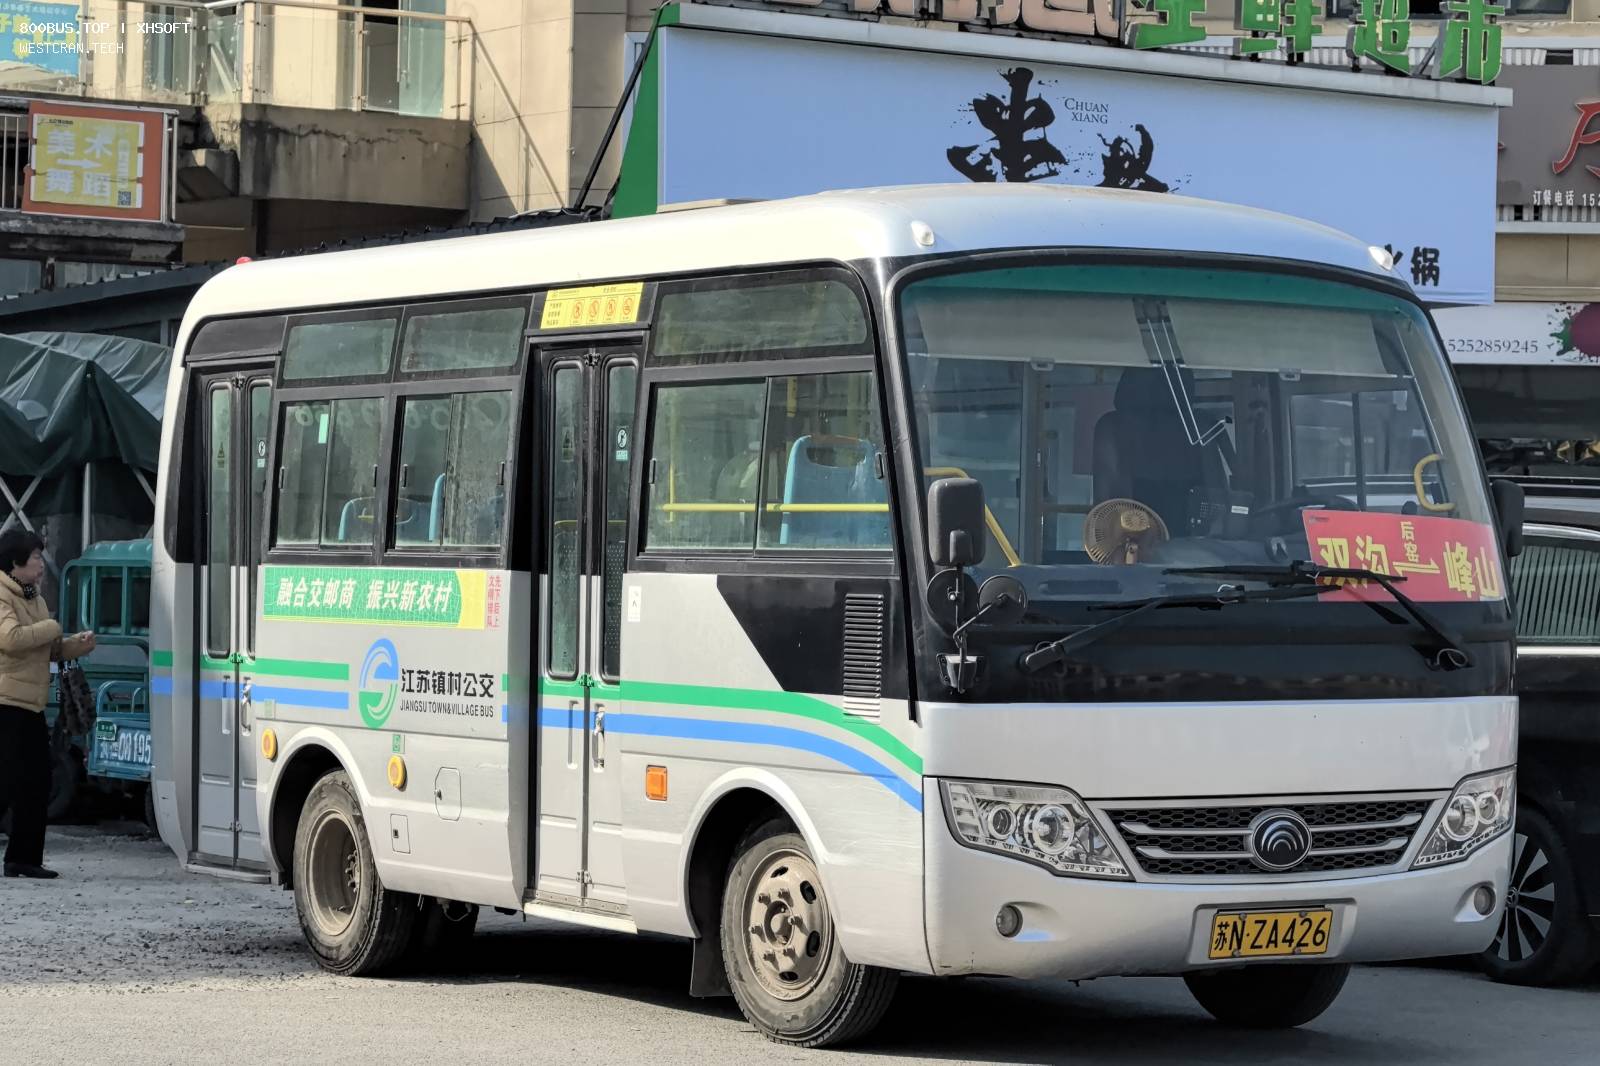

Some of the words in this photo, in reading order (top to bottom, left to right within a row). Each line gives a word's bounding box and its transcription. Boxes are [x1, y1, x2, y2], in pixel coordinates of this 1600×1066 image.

[1064, 97, 1109, 113] CHUAN
[1072, 111, 1109, 124] XIANG
[1533, 190, 1574, 206] 订餐电话
[1443, 541, 1501, 599] 峰山
[276, 577, 357, 608] 融合交邮商
[366, 579, 453, 612] 振兴新农村
[401, 668, 494, 698] 江苏镇村公交
[400, 700, 427, 713] JIANGSU
[480, 704, 494, 718] BUS
